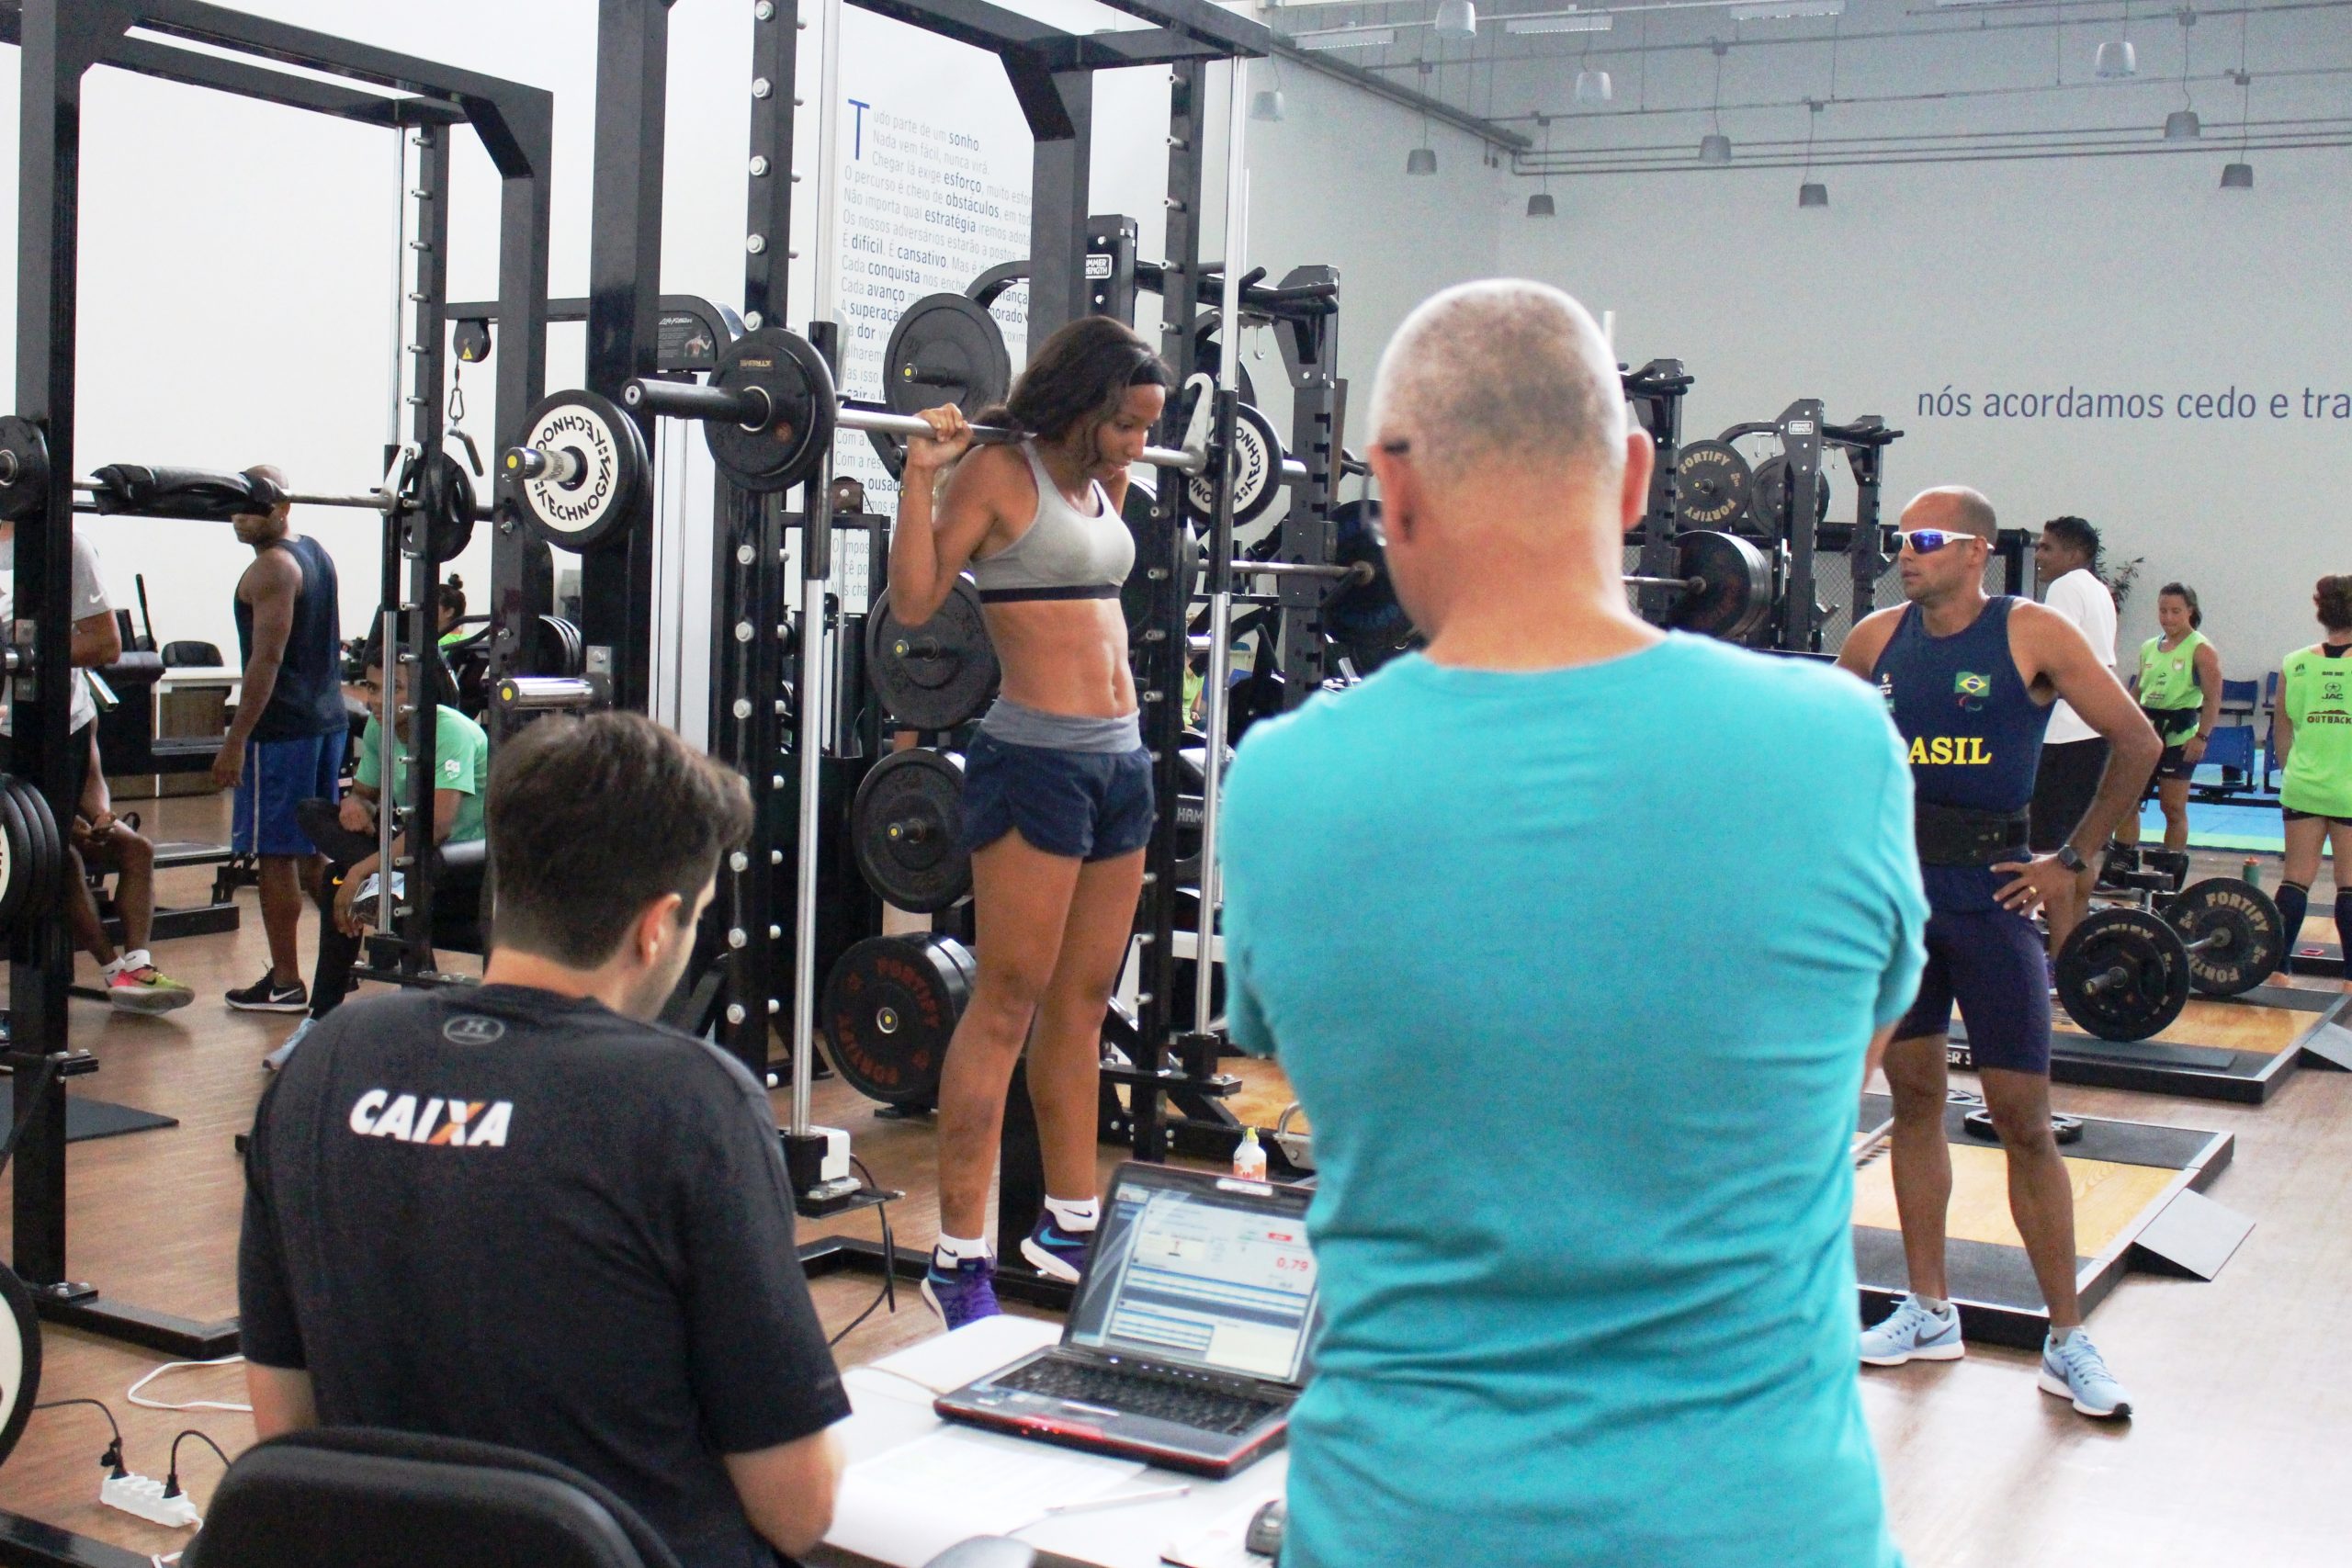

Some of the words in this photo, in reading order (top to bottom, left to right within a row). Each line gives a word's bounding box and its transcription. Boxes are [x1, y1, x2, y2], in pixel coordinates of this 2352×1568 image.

[893, 116, 917, 134] parte
[920, 121, 931, 138] de
[933, 129, 946, 141] um
[873, 130, 897, 150] Nada
[899, 140, 918, 155] vem
[944, 152, 969, 170] nunca
[844, 164, 853, 181] O
[854, 170, 896, 192] percurso
[898, 181, 904, 194] é
[906, 180, 931, 199] cheio
[932, 188, 944, 204] de
[1004, 209, 1016, 222] em
[872, 151, 904, 174] Chegar
[907, 160, 916, 175] lá
[918, 166, 942, 185] exige
[987, 184, 1009, 199] muito
[844, 187, 863, 205] Não
[865, 196, 900, 215] importa
[903, 203, 922, 221] qual
[925, 209, 976, 233] estratégia
[978, 220, 1007, 241] iremos
[843, 209, 856, 231] Os
[859, 220, 889, 234] nossos
[893, 223, 945, 246] adversários
[947, 237, 979, 255] estarão
[982, 244, 988, 256] a
[842, 231, 848, 248] É
[888, 241, 894, 256] É
[952, 256, 969, 274] Mas
[842, 254, 865, 273] Cada
[867, 261, 920, 284] conquista
[922, 273, 938, 288] nos
[841, 276, 865, 294] Cada
[867, 284, 905, 304] avanço
[857, 322, 876, 340] dor
[860, 367, 879, 384] isso
[1917, 385, 1972, 418] nós
[1984, 385, 2164, 419] acordamos
[2177, 385, 2256, 419] cedo
[2269, 392, 2290, 419] e
[2301, 387, 2352, 419] tra
[835, 428, 856, 446] Com
[859, 434, 865, 446] a
[834, 451, 855, 467] Com
[858, 457, 864, 468] a
[1679, 450, 1731, 474] FORTIFY
[537, 456, 611, 521] TECHNOGYM
[2205, 892, 2269, 931] FORTIFY
[349, 1089, 514, 1146] CAIXA
